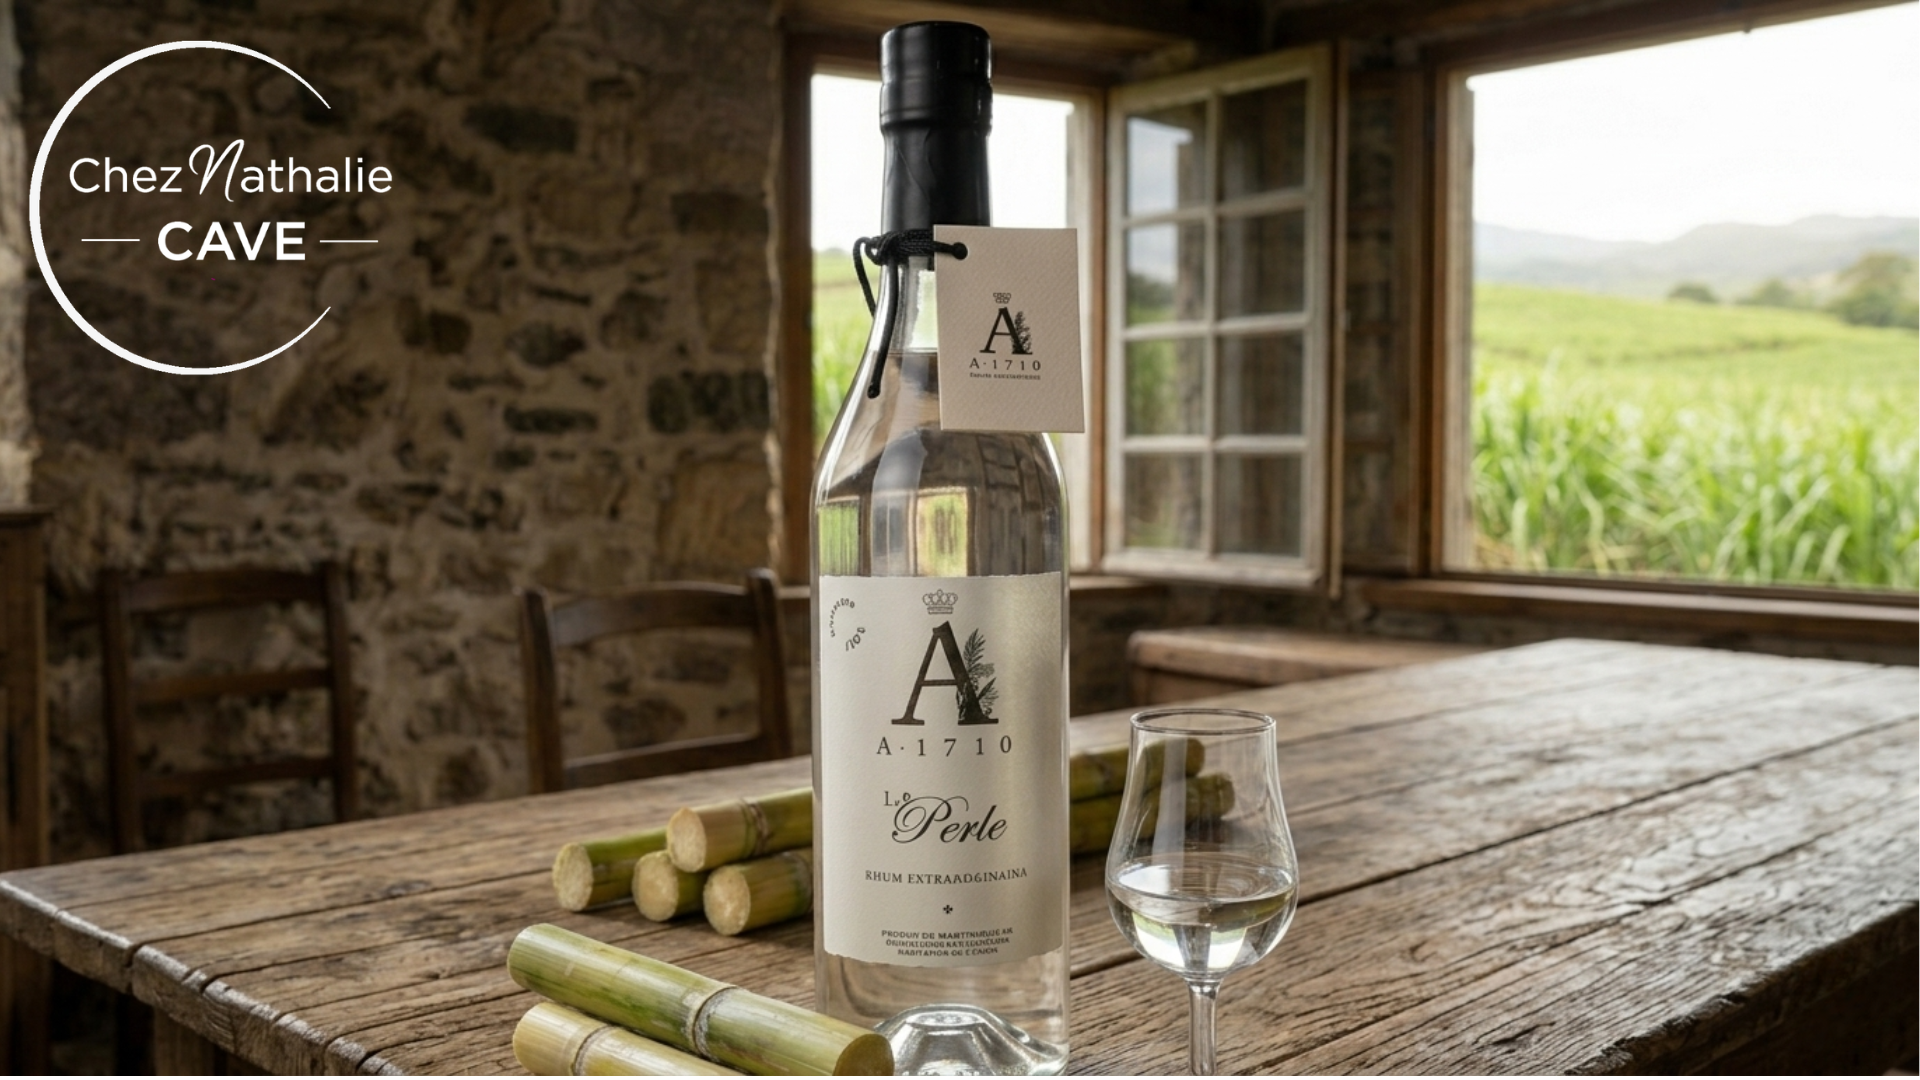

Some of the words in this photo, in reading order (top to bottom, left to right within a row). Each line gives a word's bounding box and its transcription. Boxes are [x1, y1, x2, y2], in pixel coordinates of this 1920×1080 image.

[891, 620, 999, 726] A
[891, 796, 1008, 844] Perle
[865, 870, 903, 883] RHUM
